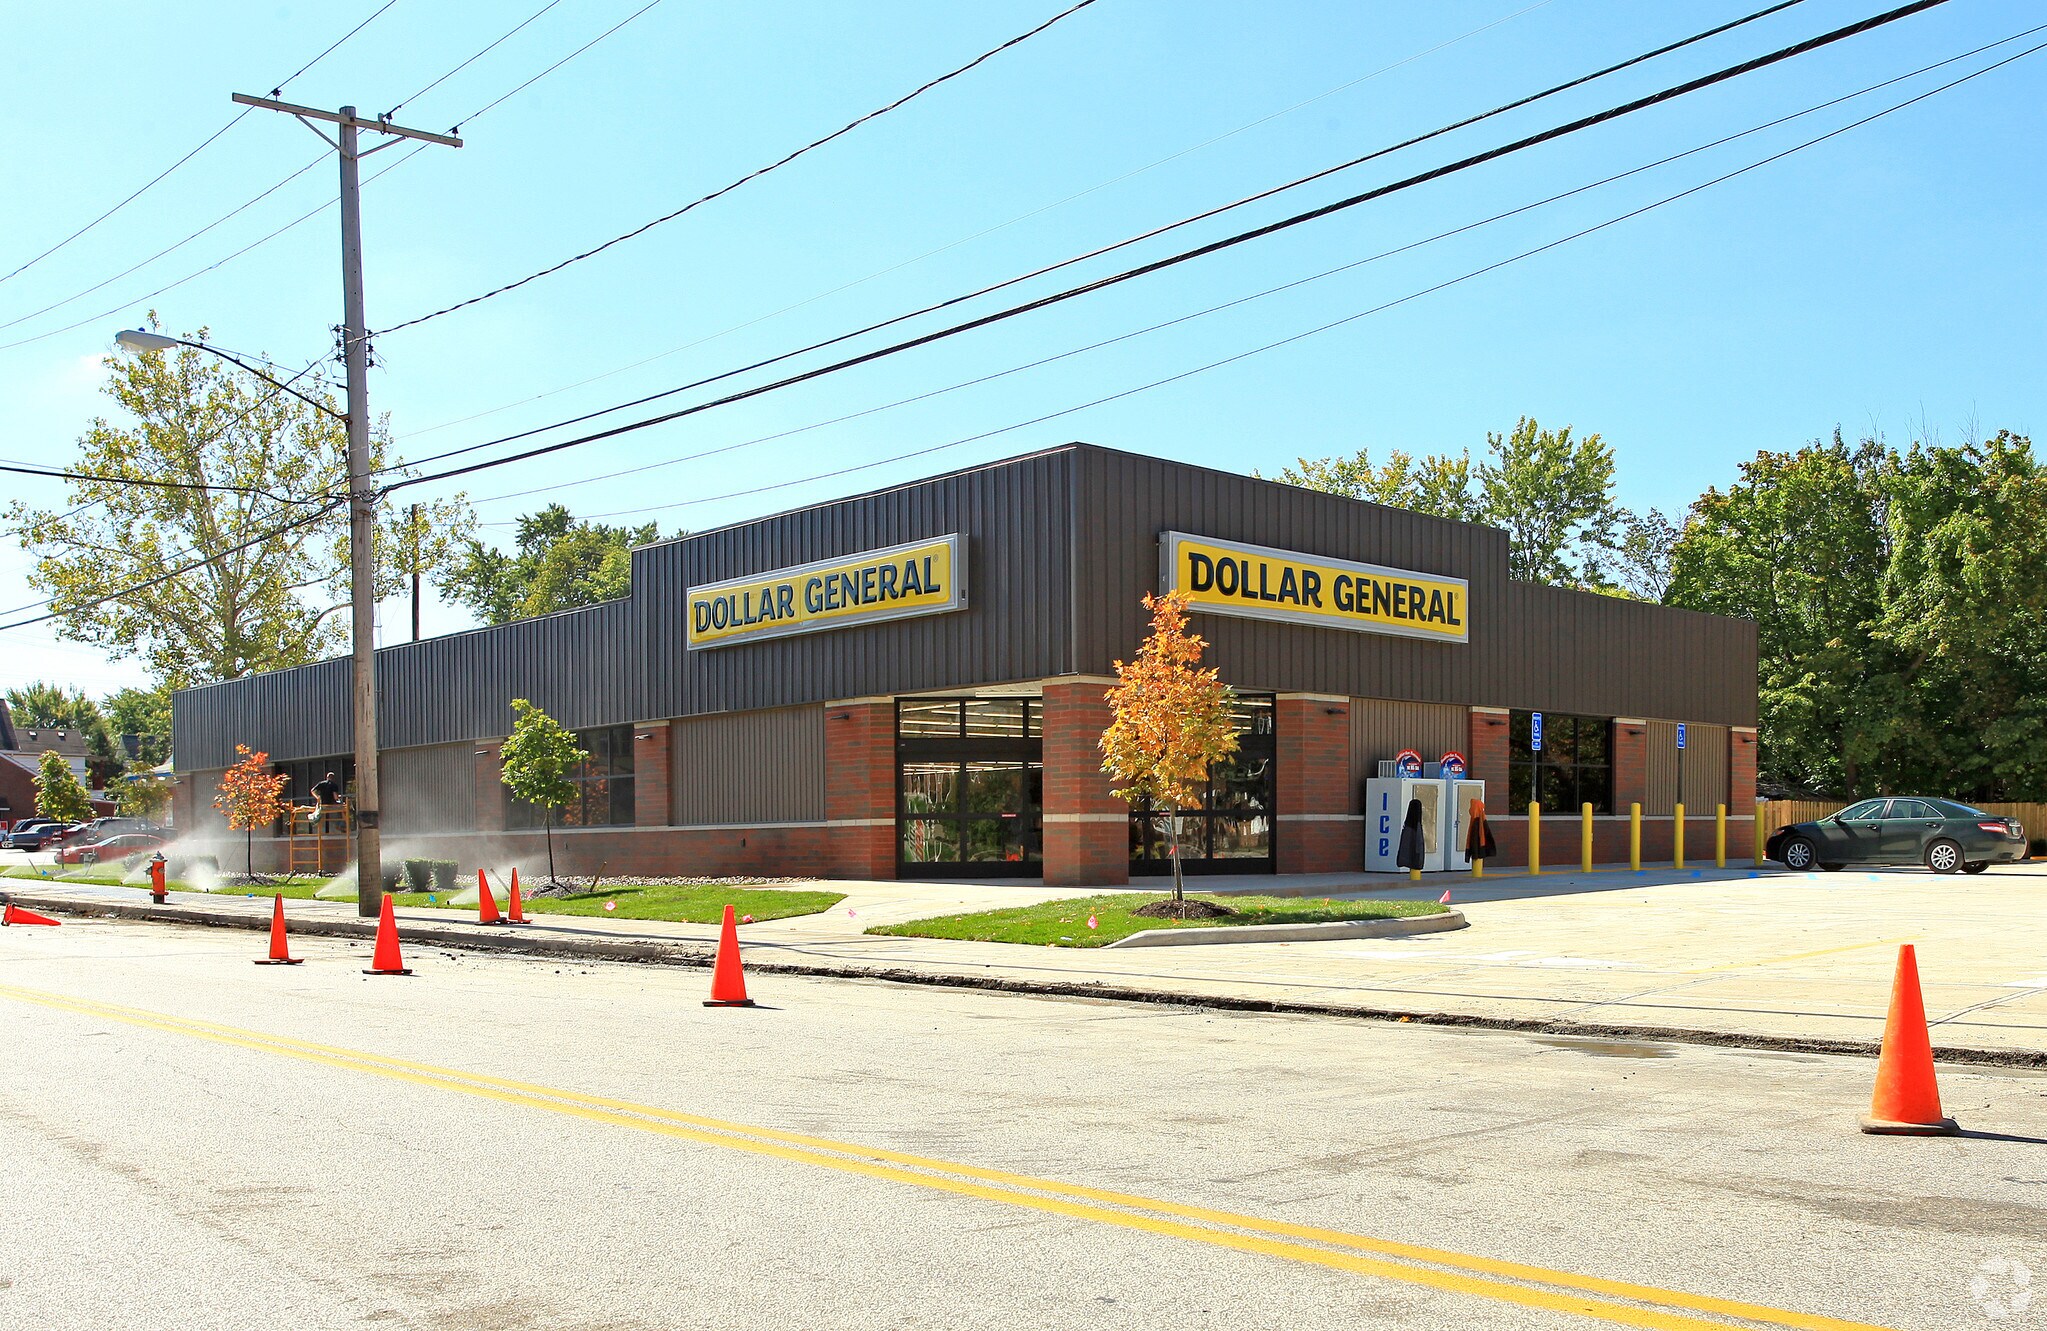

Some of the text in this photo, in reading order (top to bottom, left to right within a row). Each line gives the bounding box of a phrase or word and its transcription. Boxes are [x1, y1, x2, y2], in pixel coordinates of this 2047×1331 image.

[694, 555, 941, 633] DOLLAR GENERAL
[1188, 552, 1461, 626] DOLLAR GENERAL
